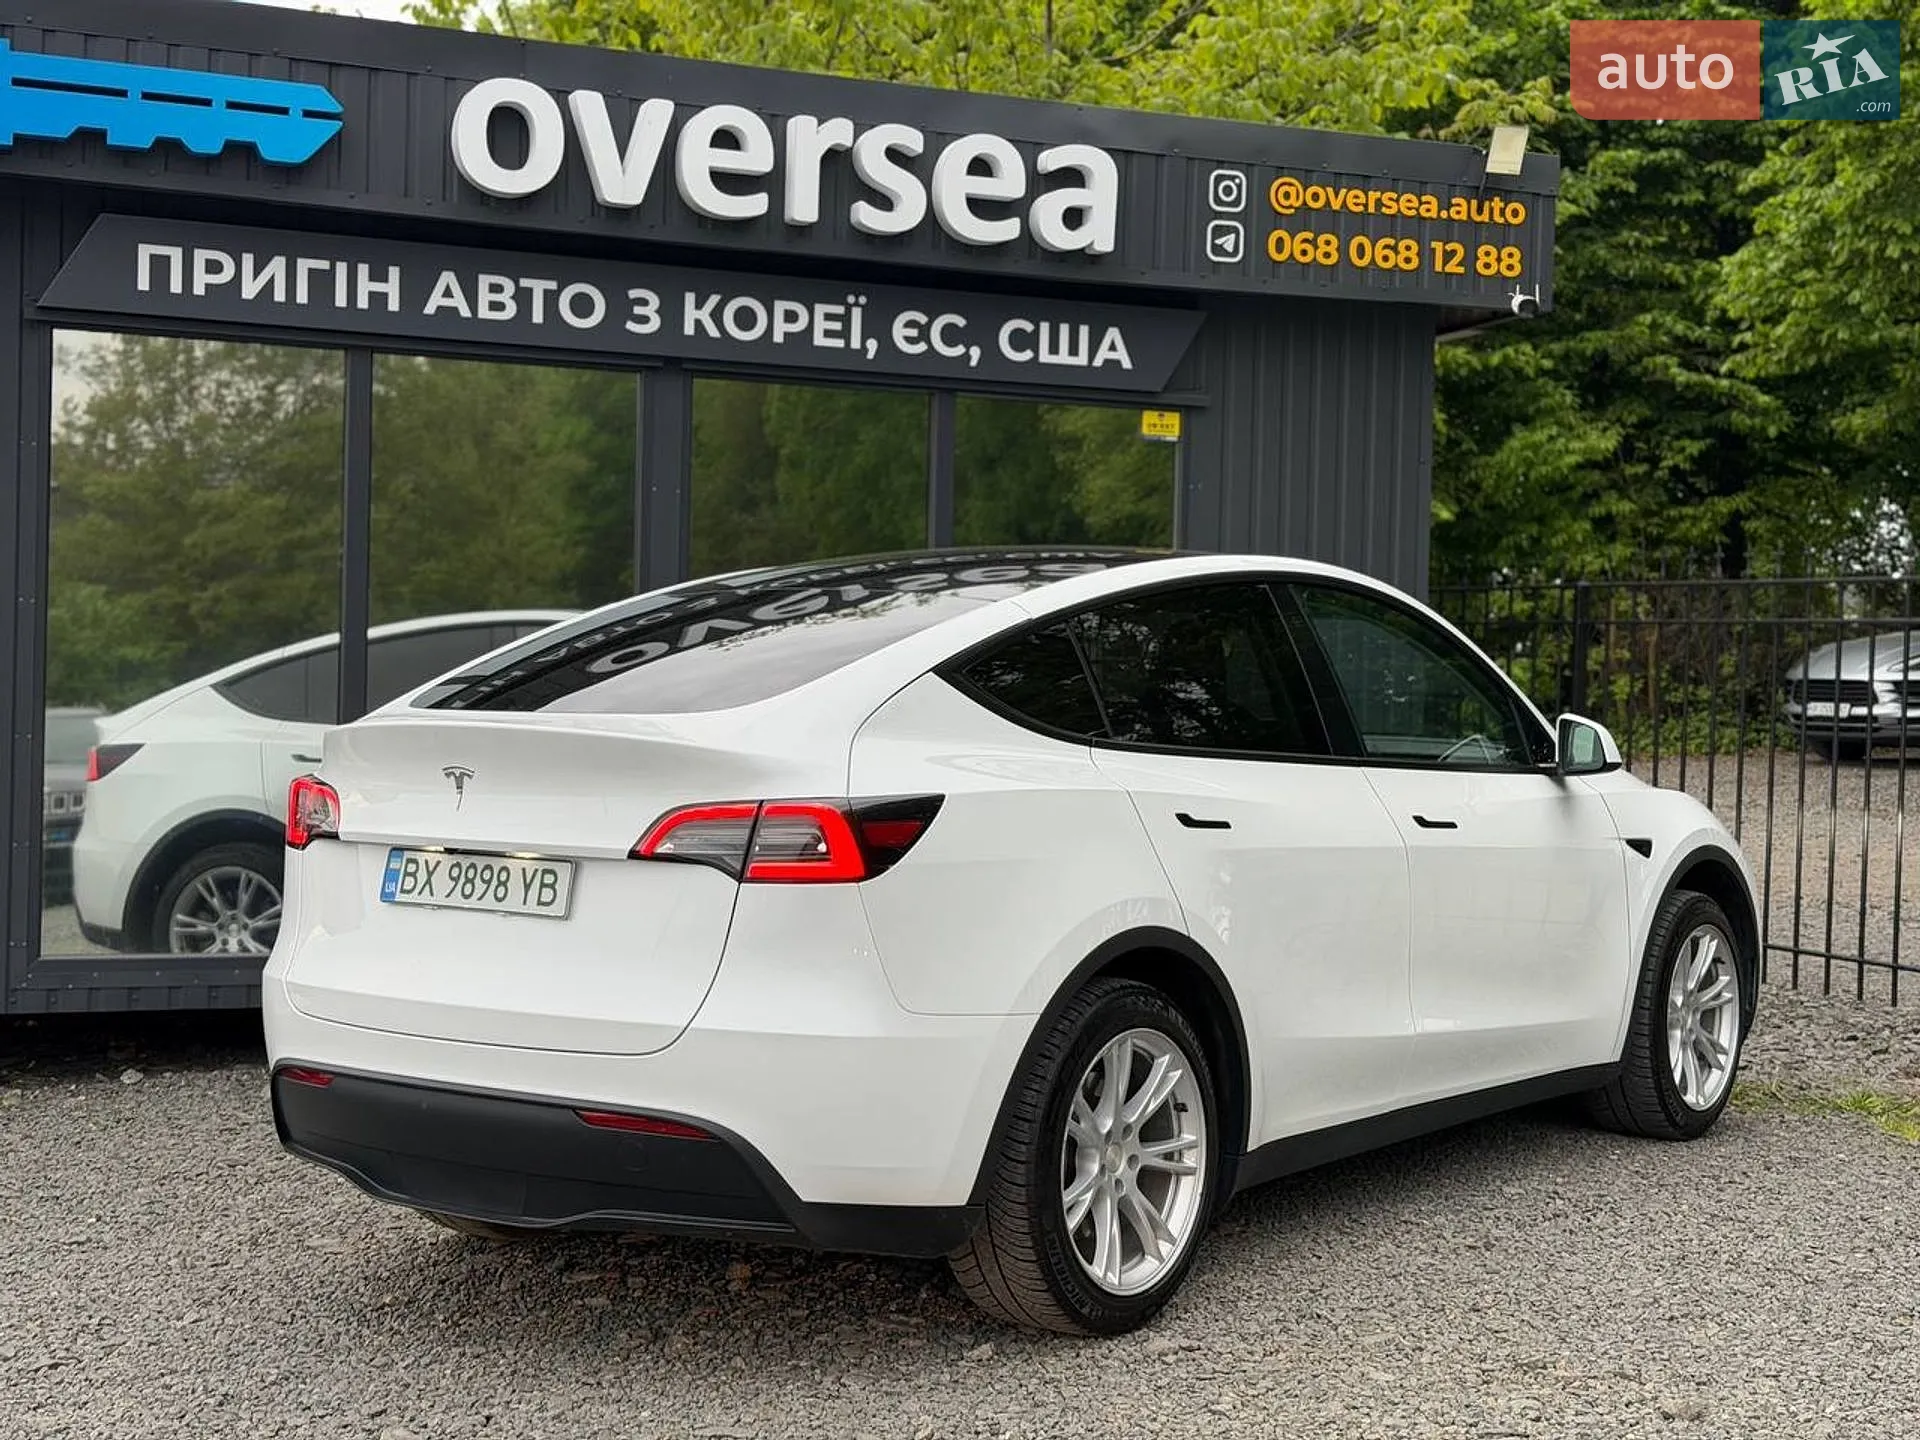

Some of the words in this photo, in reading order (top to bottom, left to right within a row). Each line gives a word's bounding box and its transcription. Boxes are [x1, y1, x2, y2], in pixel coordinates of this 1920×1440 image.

[450, 76, 1119, 255] oversea
[1268, 177, 1528, 226] @oversea.auto
[1267, 228, 1341, 266] 068
[1348, 234, 1421, 272] 068
[1431, 240, 1466, 275] 12
[1475, 244, 1523, 279] 88
[136, 243, 400, 312] ПРИГІН
[422, 271, 606, 329] АВТО
[625, 288, 661, 334] З
[683, 291, 878, 360] КОРЕЇ,
[892, 310, 981, 367] ЄС,
[998, 318, 1133, 370] США
[399, 857, 442, 897] BX
[444, 861, 511, 903] 9898
[521, 867, 559, 907] YB
